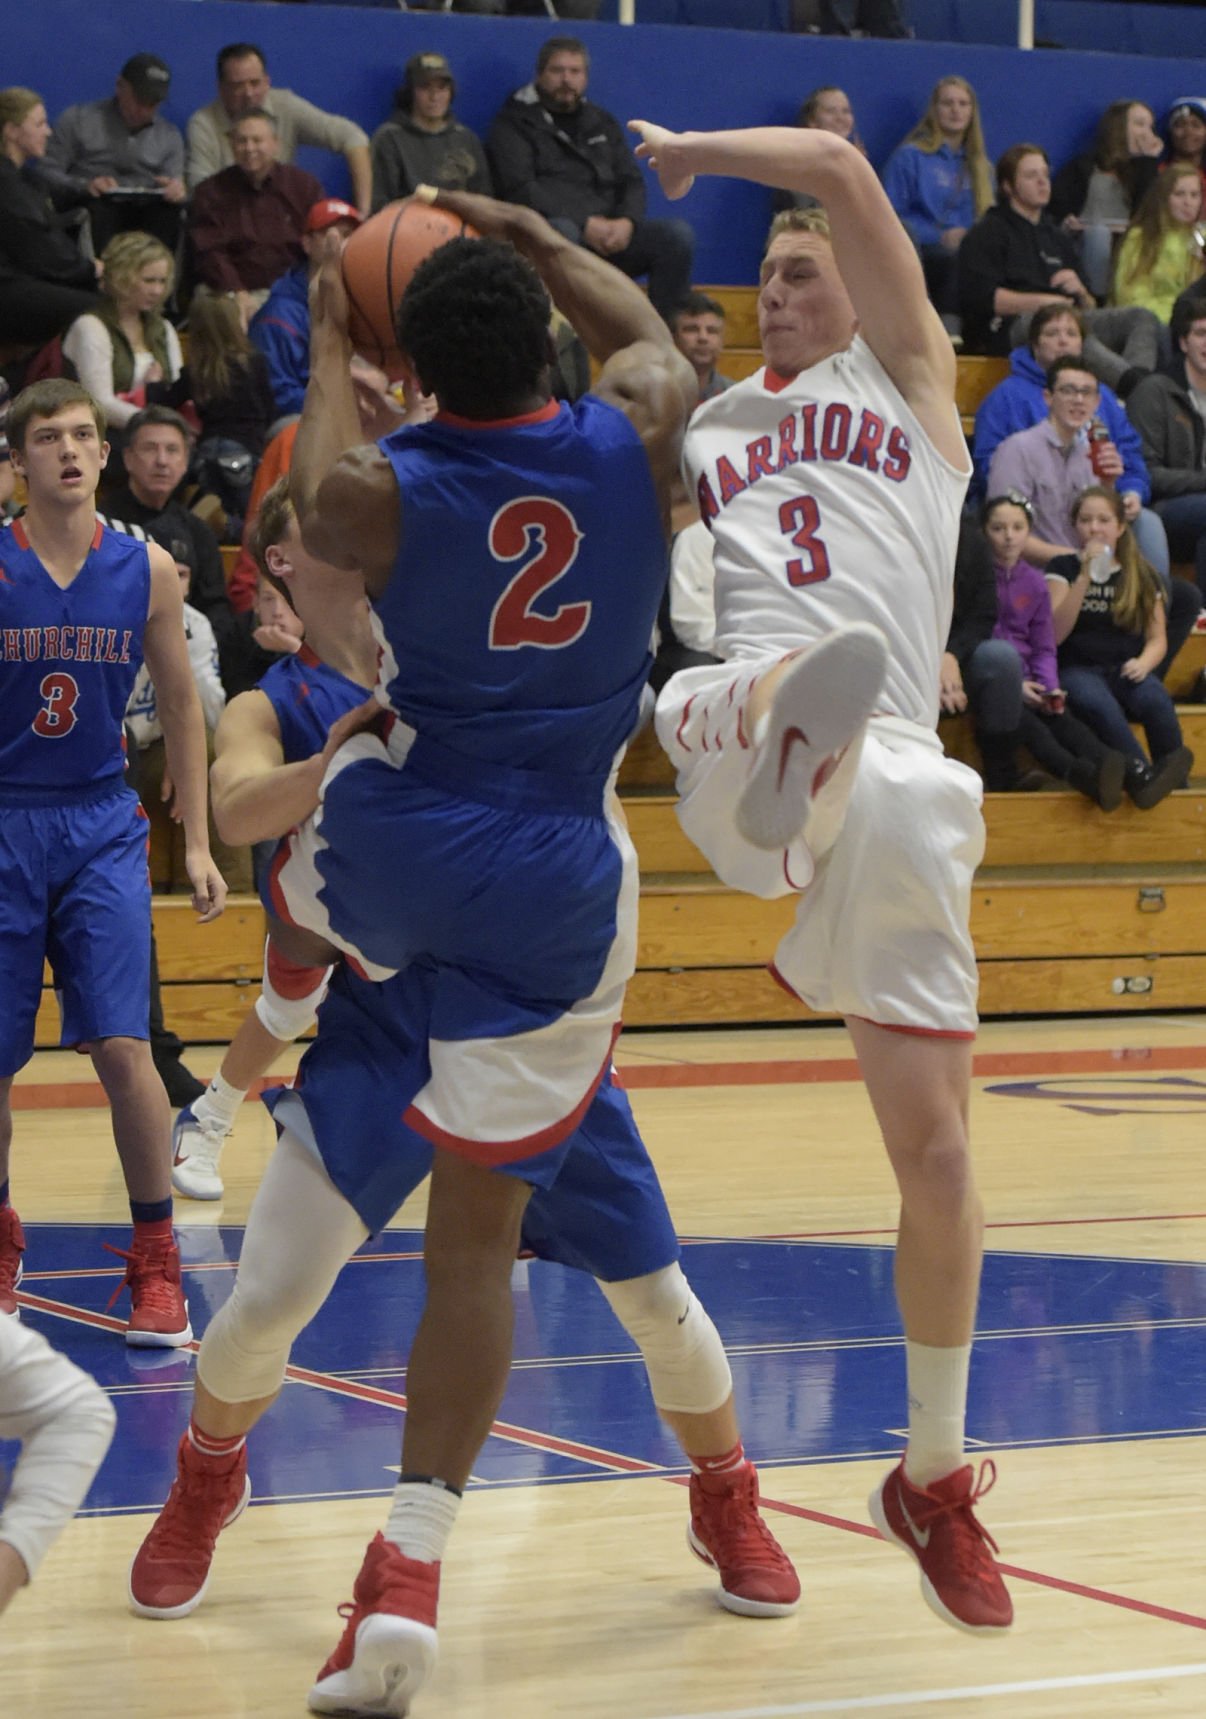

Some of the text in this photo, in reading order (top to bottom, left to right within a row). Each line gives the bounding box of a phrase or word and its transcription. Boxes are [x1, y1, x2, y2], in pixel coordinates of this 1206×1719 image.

[488, 496, 592, 650] 2
[778, 495, 831, 587] 3
[0, 626, 132, 663] HURCHILL
[32, 672, 80, 738] 3
